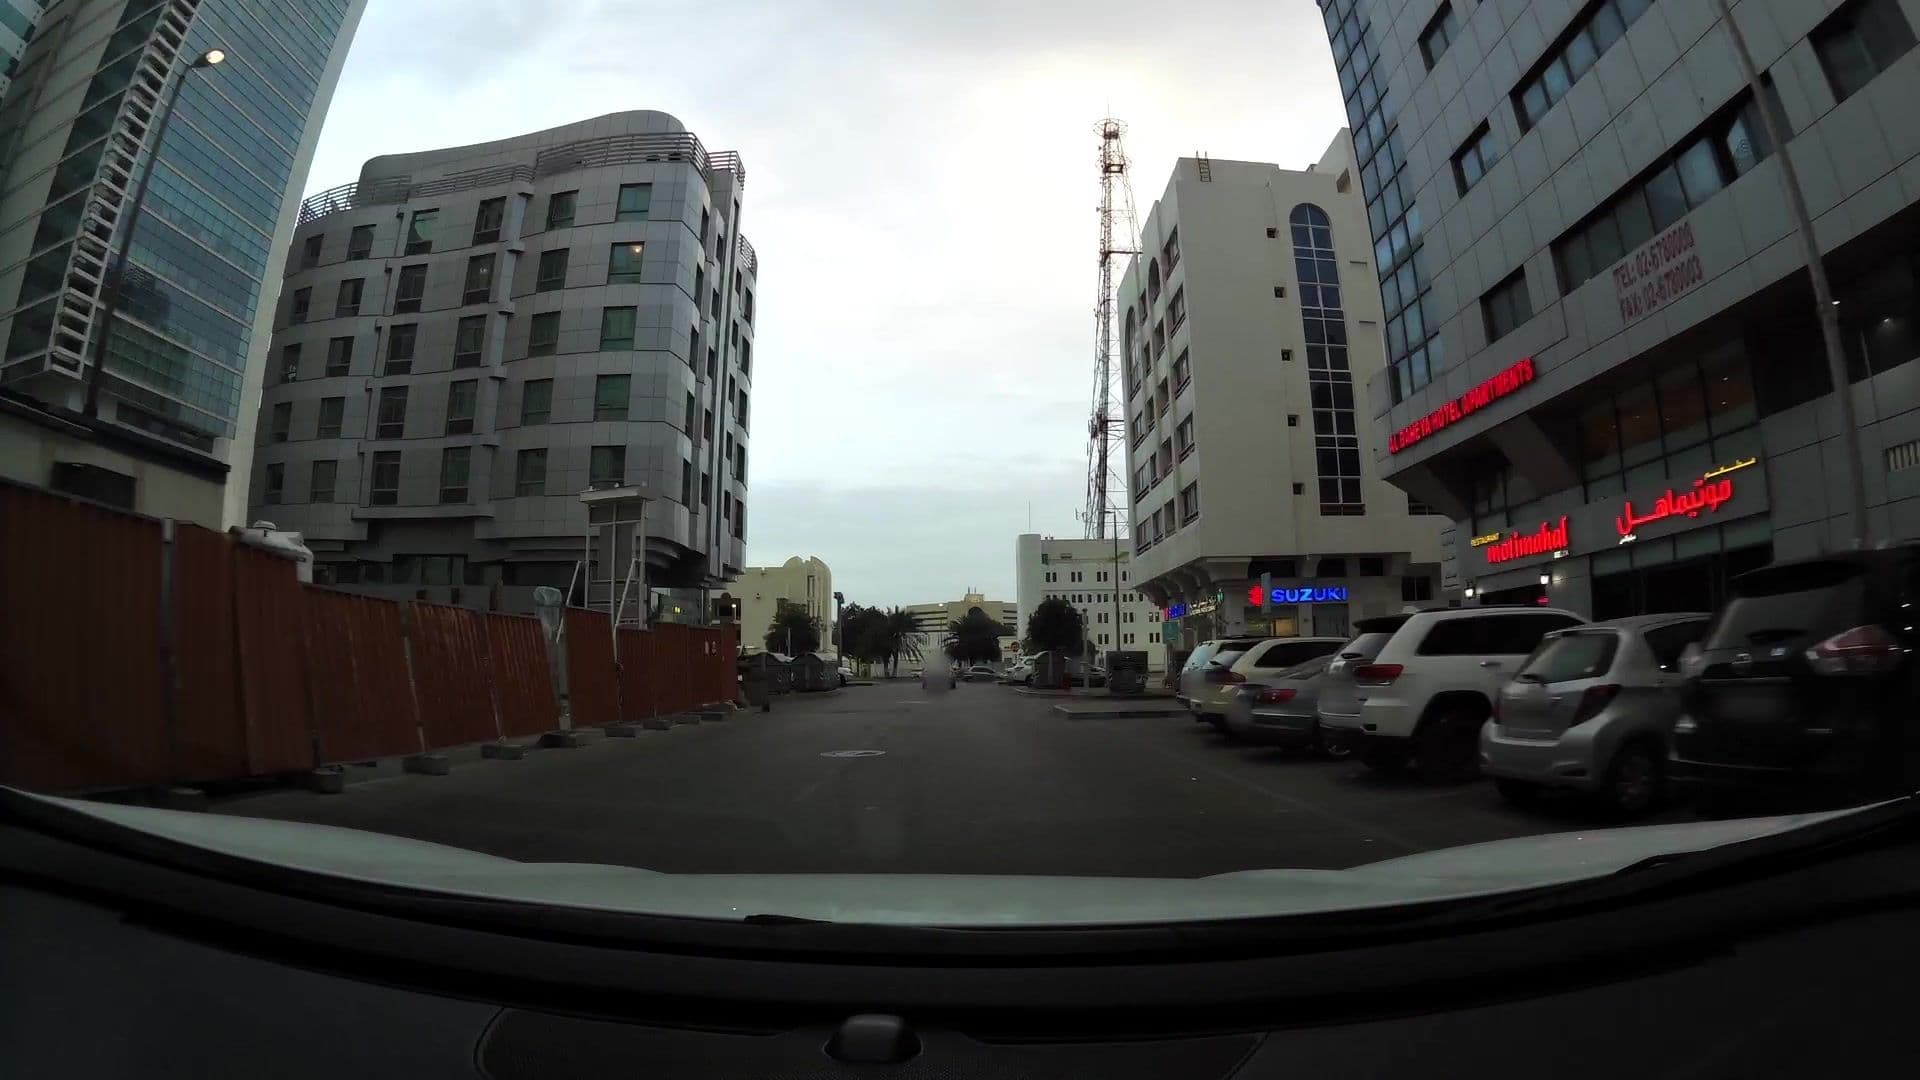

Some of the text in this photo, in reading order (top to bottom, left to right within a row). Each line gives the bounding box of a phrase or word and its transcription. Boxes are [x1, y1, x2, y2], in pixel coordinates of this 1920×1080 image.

[1431, 399, 1461, 433] HOTEL
[1462, 357, 1535, 414] APARTMENTS
[1271, 587, 1347, 603] SUZUKI
